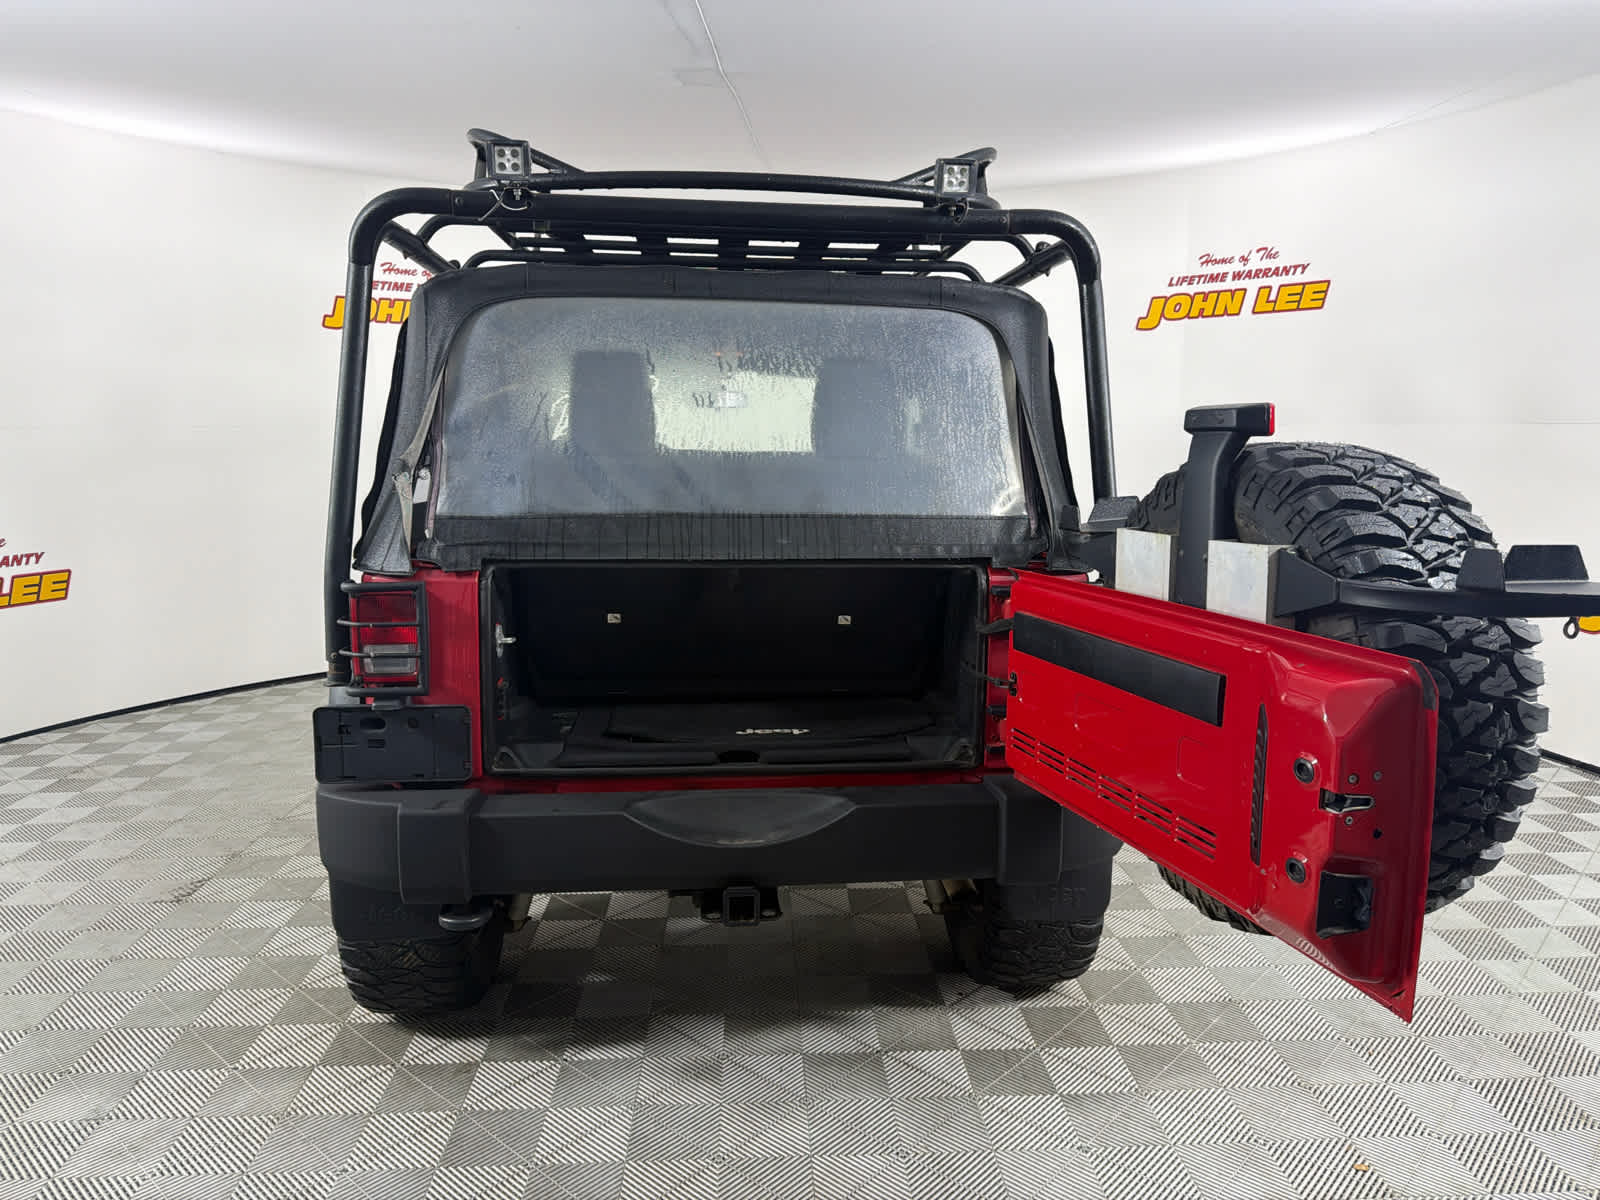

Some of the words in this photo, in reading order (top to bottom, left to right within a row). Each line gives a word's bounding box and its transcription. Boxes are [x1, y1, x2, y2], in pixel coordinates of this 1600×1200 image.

[1199, 253, 1234, 267] Home
[1238, 250, 1251, 264] of
[1256, 246, 1279, 260] The
[380, 262, 417, 276] Home
[1168, 271, 1229, 287] LIFETIME
[1231, 263, 1310, 281] WARRANTY
[371, 280, 414, 292] ETIME
[1136, 288, 1247, 331] JOHN
[1252, 280, 1331, 314] LEE
[0, 552, 45, 568] ANTY
